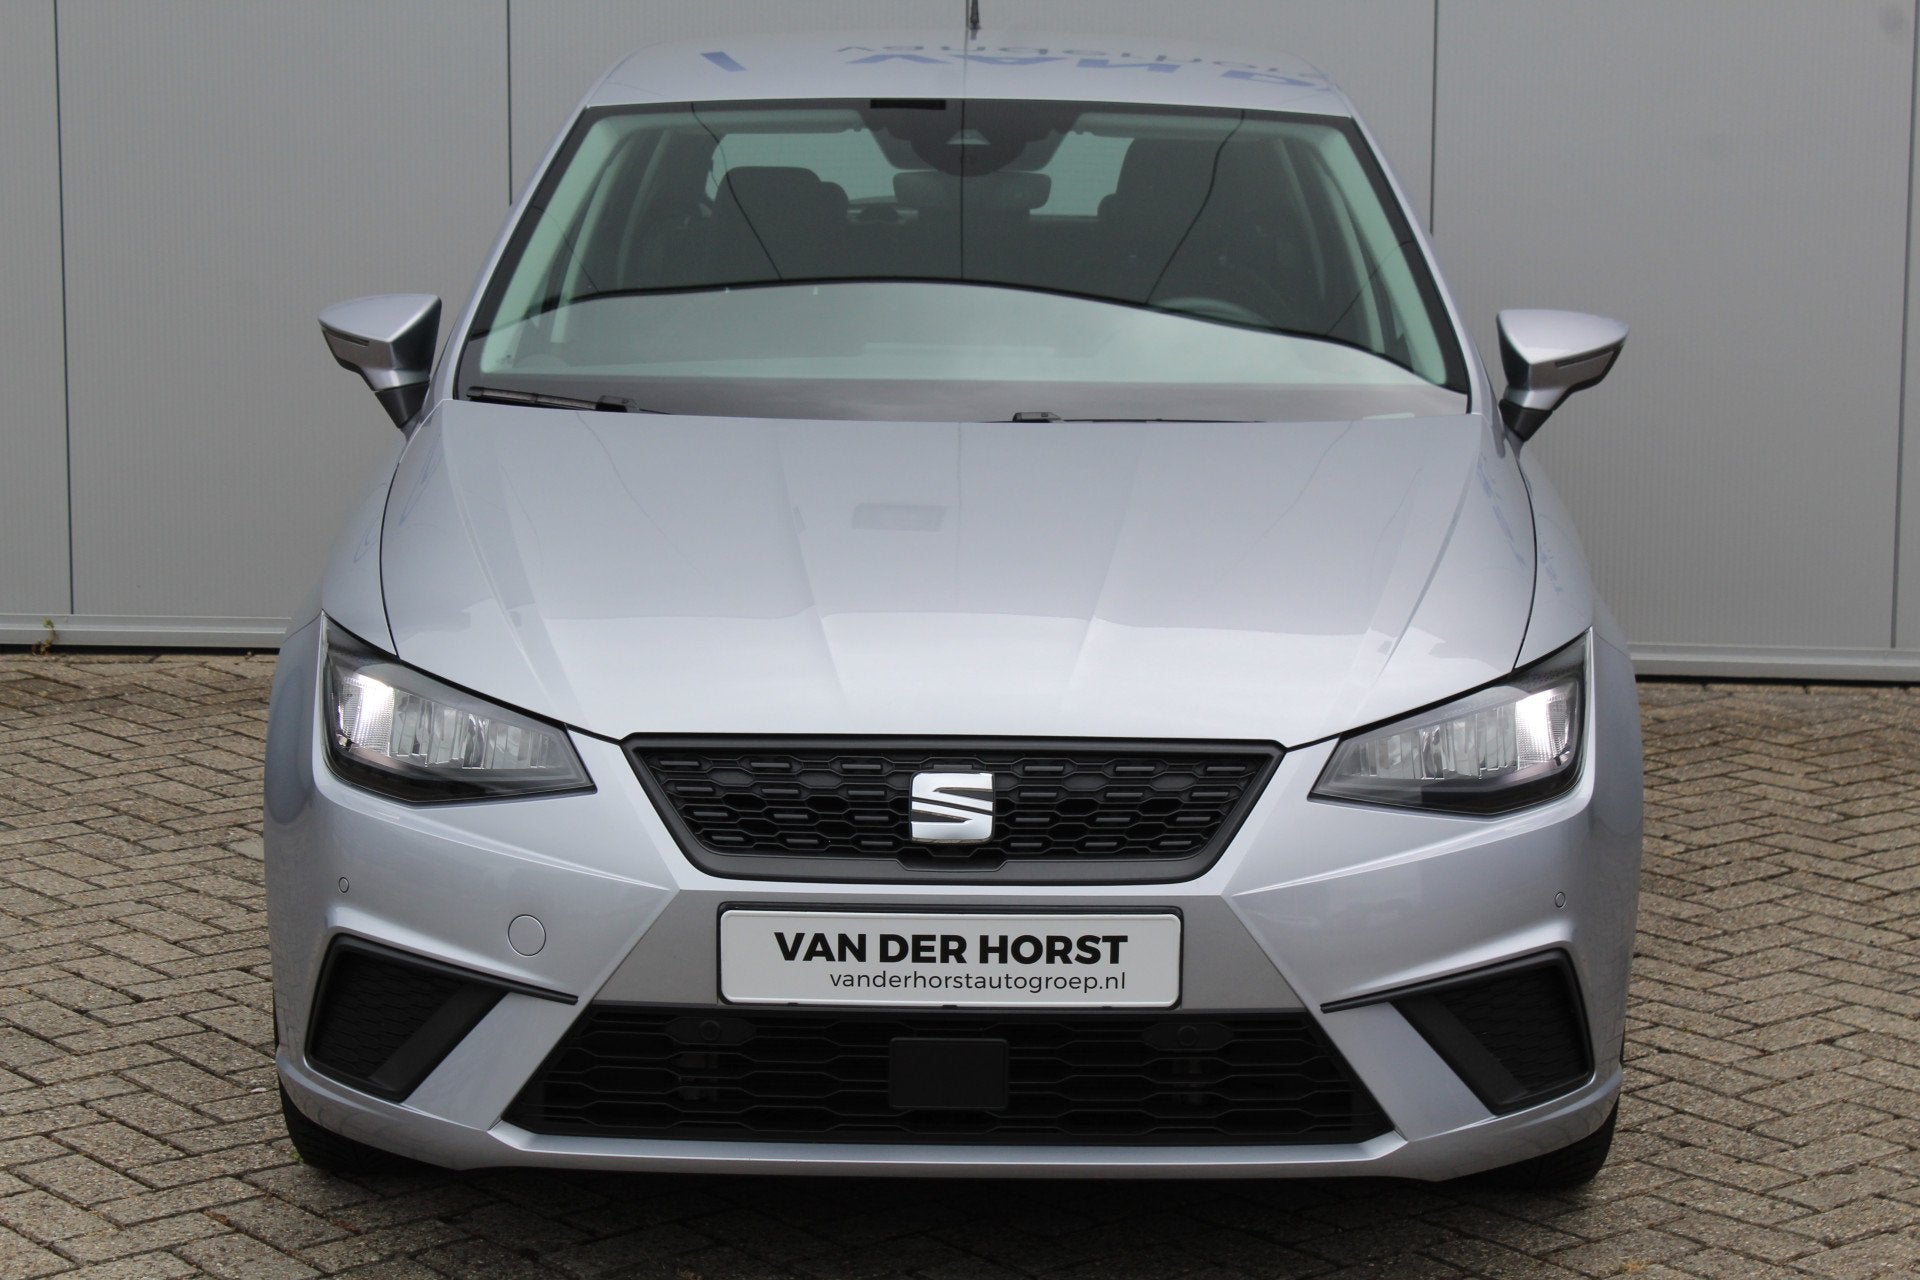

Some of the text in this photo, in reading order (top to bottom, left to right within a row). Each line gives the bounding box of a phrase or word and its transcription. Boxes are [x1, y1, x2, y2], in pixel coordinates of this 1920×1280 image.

[774, 931, 1129, 965] VAN DER HORST
[829, 970, 1126, 993] vanderhorstautogroep.nl
